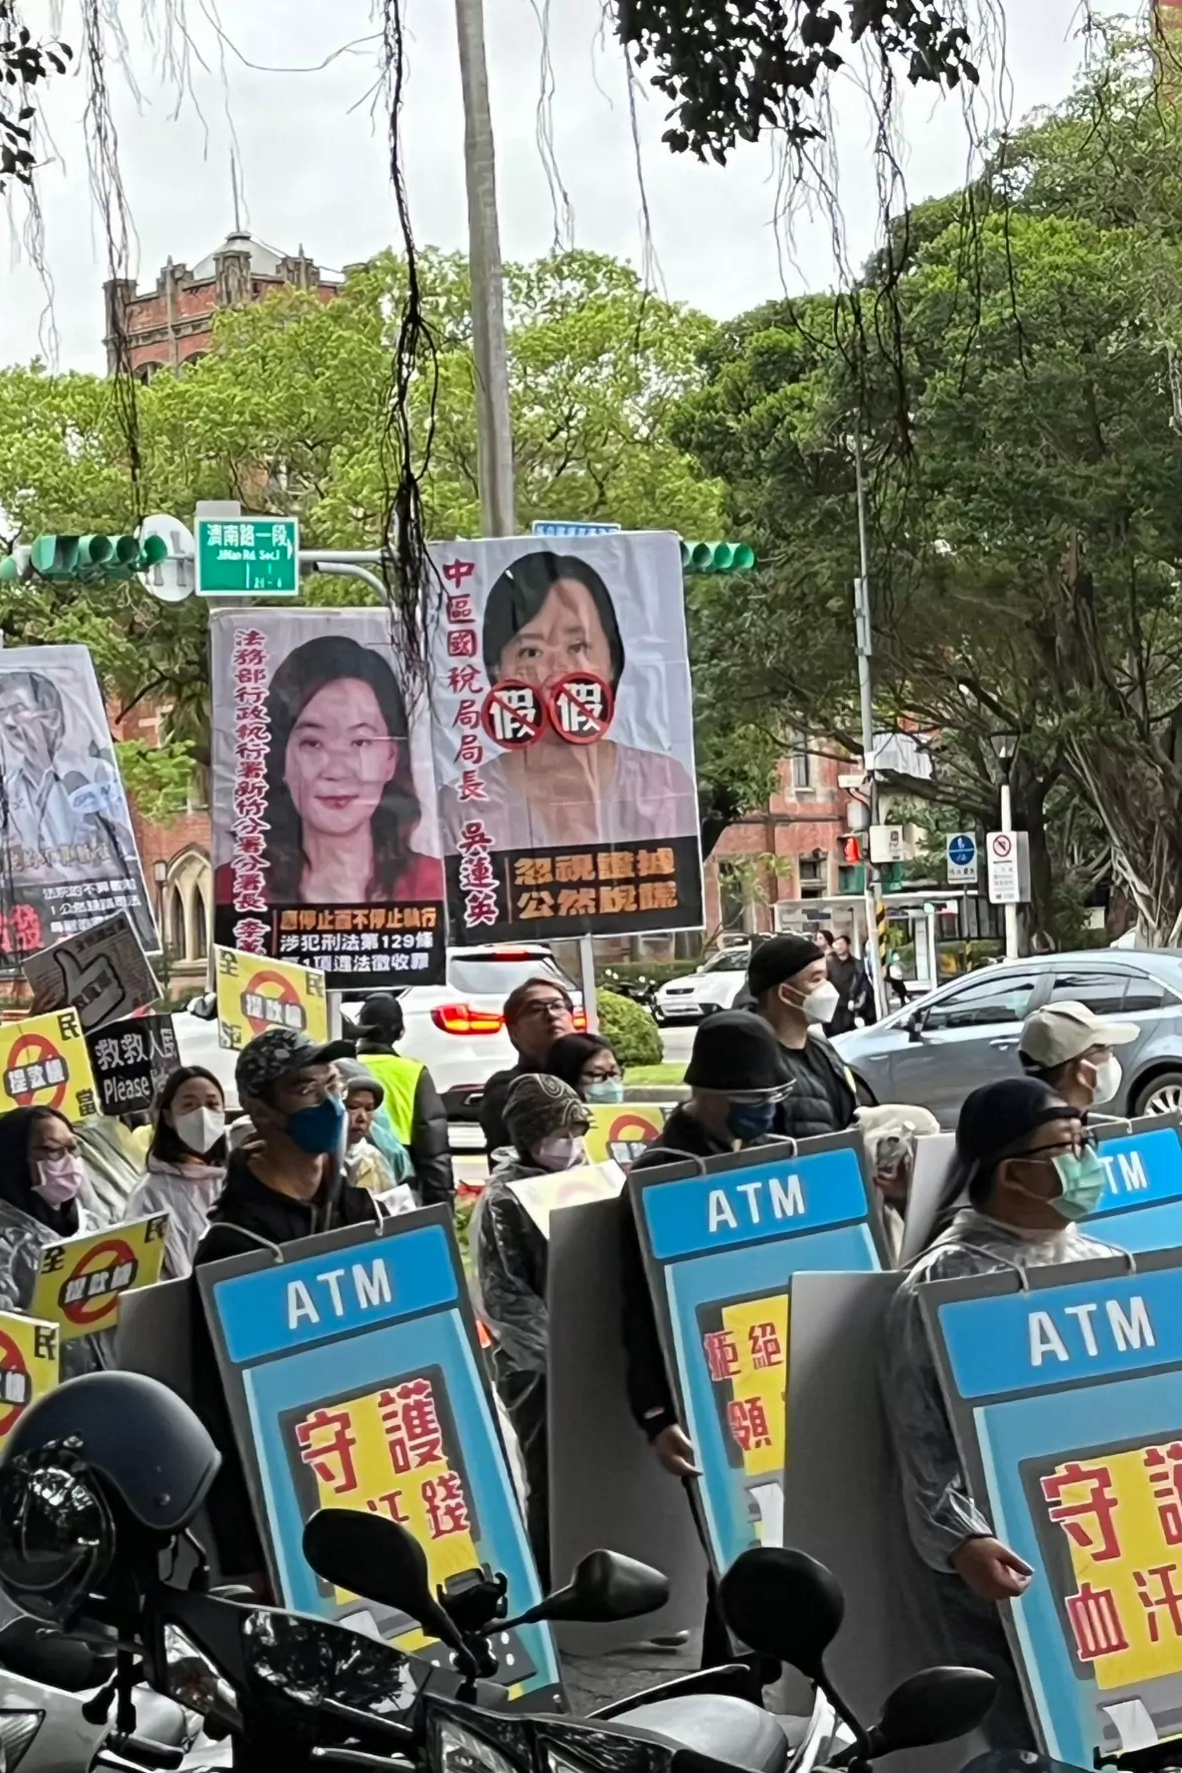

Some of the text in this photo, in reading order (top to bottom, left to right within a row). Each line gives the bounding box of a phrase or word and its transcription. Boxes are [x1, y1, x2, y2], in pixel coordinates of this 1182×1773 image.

[206, 523, 287, 547] 濟南路一段
[489, 687, 536, 740] 假
[555, 682, 604, 732] 假
[442, 558, 500, 928] 中區國稅局局長 吳蓮英
[514, 847, 676, 886] 忽視證據
[280, 907, 437, 931] 應停止而不停止執行
[517, 880, 678, 919] 公然說謊
[280, 931, 434, 952] 涉犯刑法第129條
[219, 949, 324, 997] 全 民
[57, 1012, 80, 1041] 民
[95, 1028, 177, 1070] 救救人民
[8, 1059, 65, 1093] 提款機
[103, 1076, 151, 1104] Please
[75, 1088, 98, 1117] 當
[1101, 1151, 1148, 1194] TM
[707, 1174, 806, 1233] ATM
[41, 1213, 169, 1274] 全 民
[285, 1258, 393, 1330] ATM
[34, 1325, 59, 1360] 民
[704, 1323, 785, 1380] 拒絕
[1028, 1296, 1155, 1366] ATM
[296, 1378, 447, 1494] 守護
[1065, 1563, 1182, 1662] 血汗
